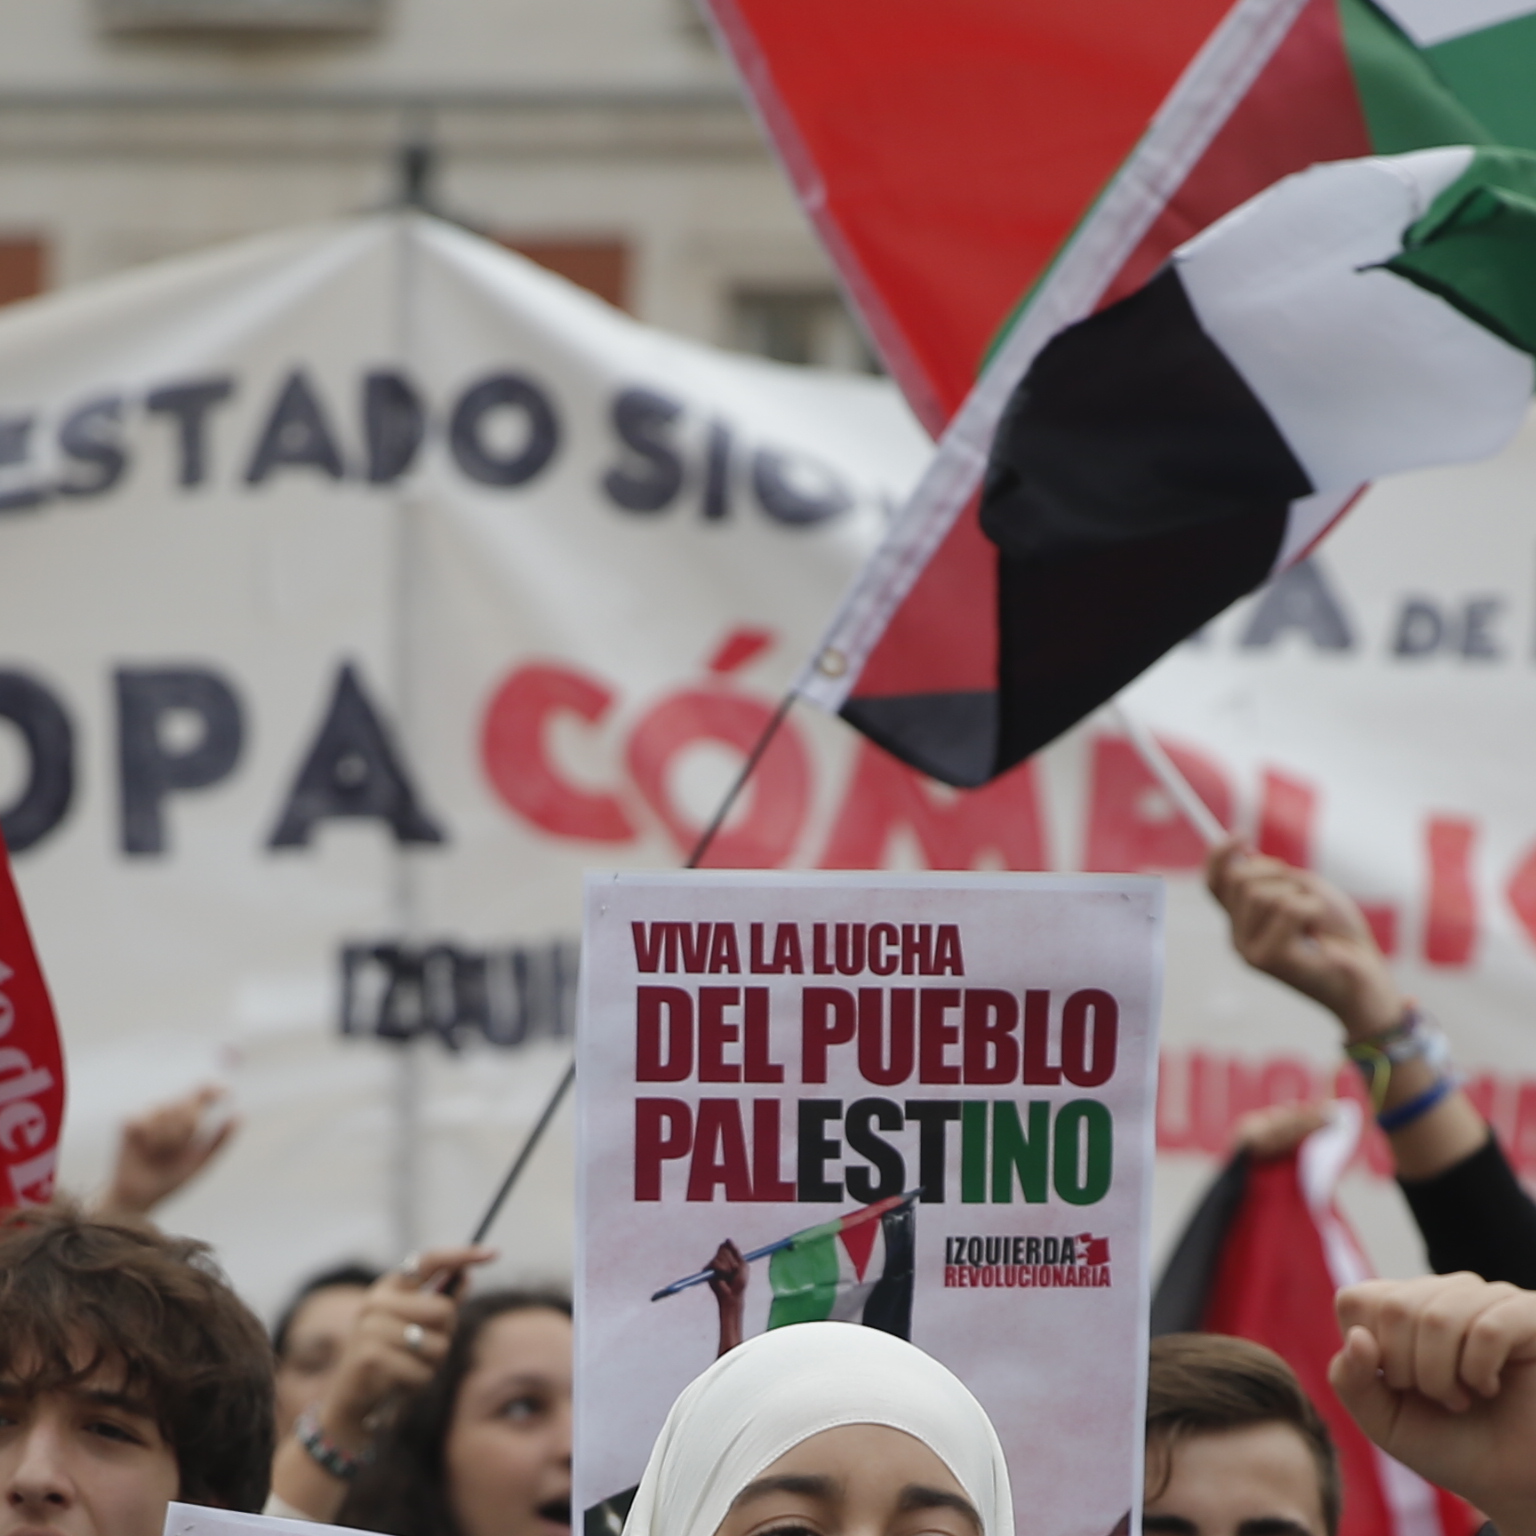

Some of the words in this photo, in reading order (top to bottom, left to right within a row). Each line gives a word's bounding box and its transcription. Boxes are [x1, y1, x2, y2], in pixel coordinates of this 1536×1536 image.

[1390, 595, 1508, 662] DE
[631, 921, 740, 974] VIVA
[750, 922, 804, 975] LA
[812, 923, 965, 976] LUCHA
[635, 986, 784, 1083] DEL
[801, 986, 1119, 1087] PUEBLO
[634, 1097, 1113, 1206] PALESTINO
[944, 1265, 1111, 1287] REVOLUCIONARIA
[945, 1236, 1076, 1266] IZQUIERDA
